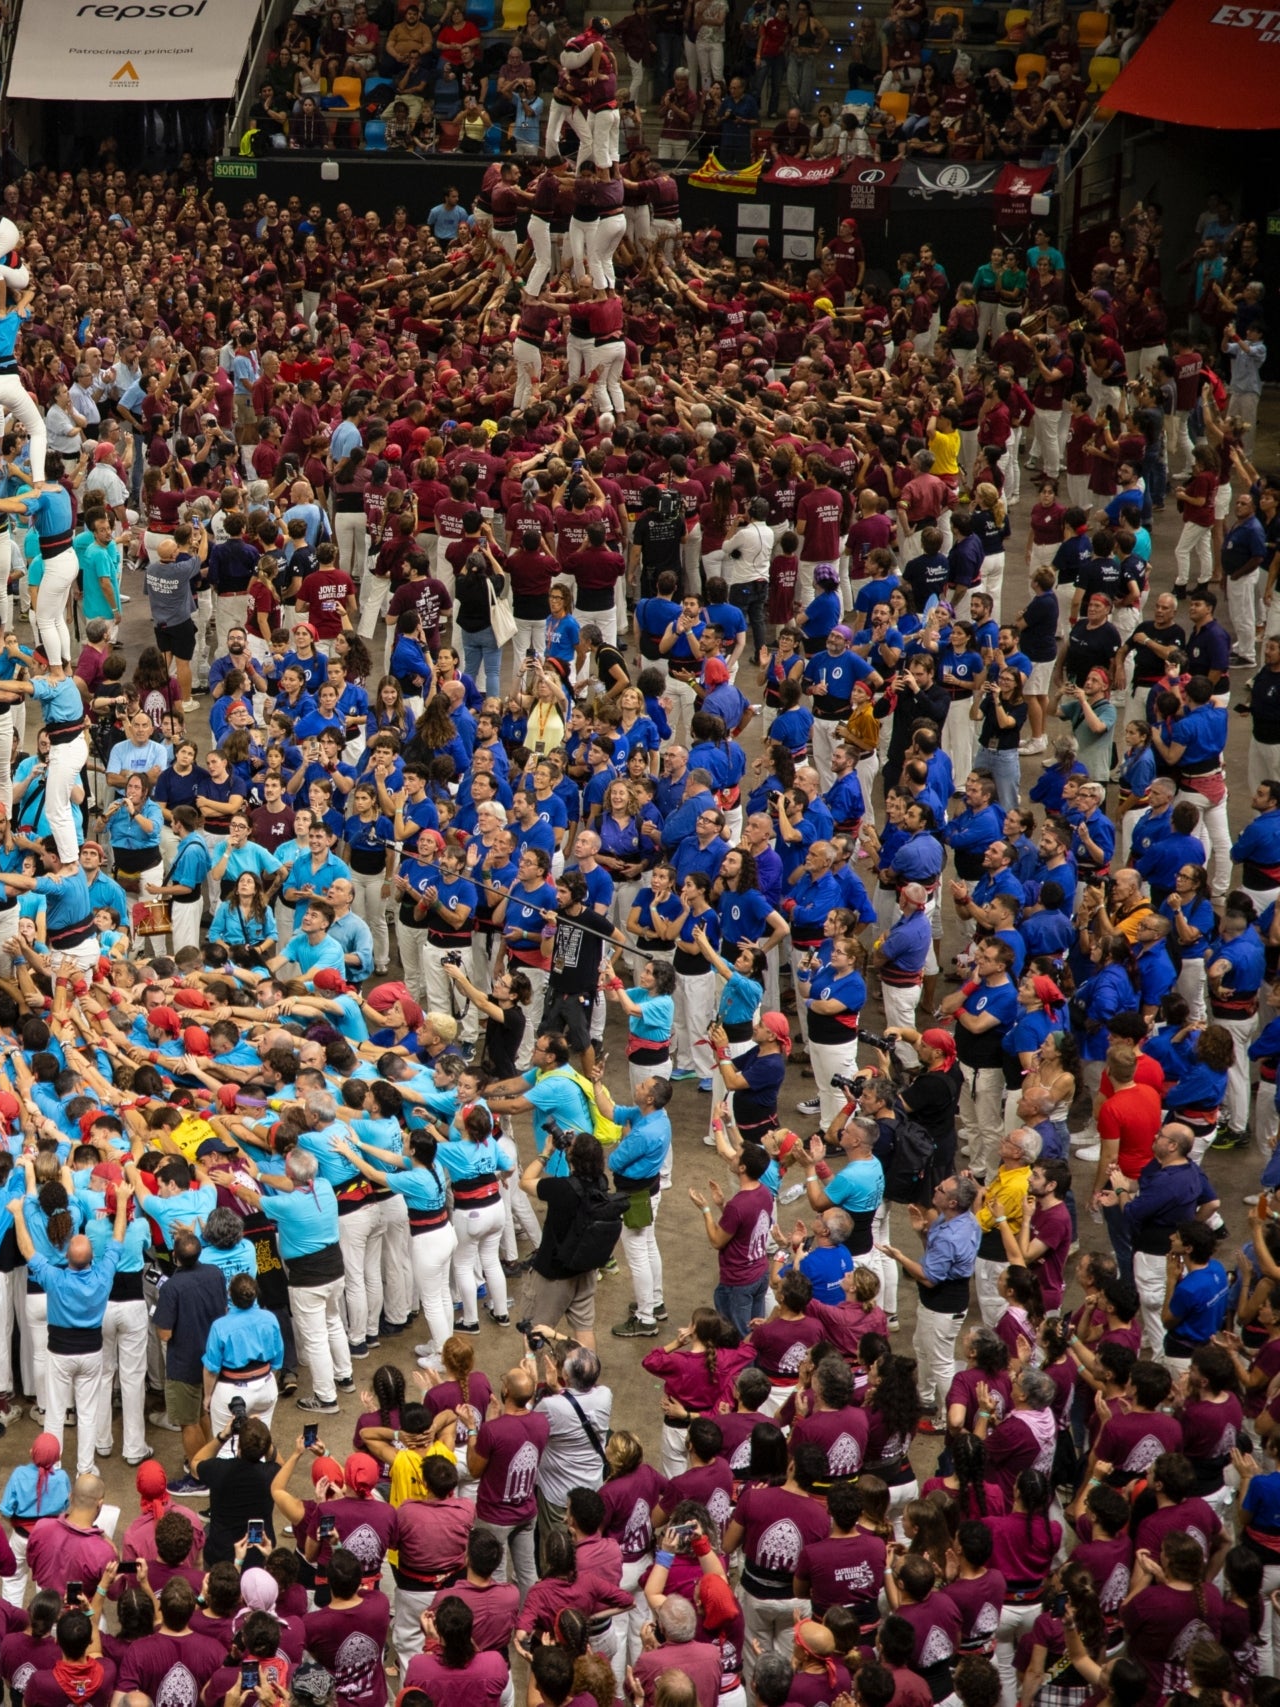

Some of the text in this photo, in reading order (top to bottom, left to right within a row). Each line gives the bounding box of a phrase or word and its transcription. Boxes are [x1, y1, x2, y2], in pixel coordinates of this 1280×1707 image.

[76, 0, 208, 21] repsol
[68, 47, 194, 55] Patrocinador principal
[216, 164, 255, 176] SORTIDA
[806, 166, 835, 177] COLLA
[851, 184, 875, 194] COLLA
[160, 577, 179, 585] BRAND
[318, 584, 348, 595] JOVE DE
[834, 1565, 863, 1576] CASTELLERS
[844, 1572, 864, 1580] LLEIDA
